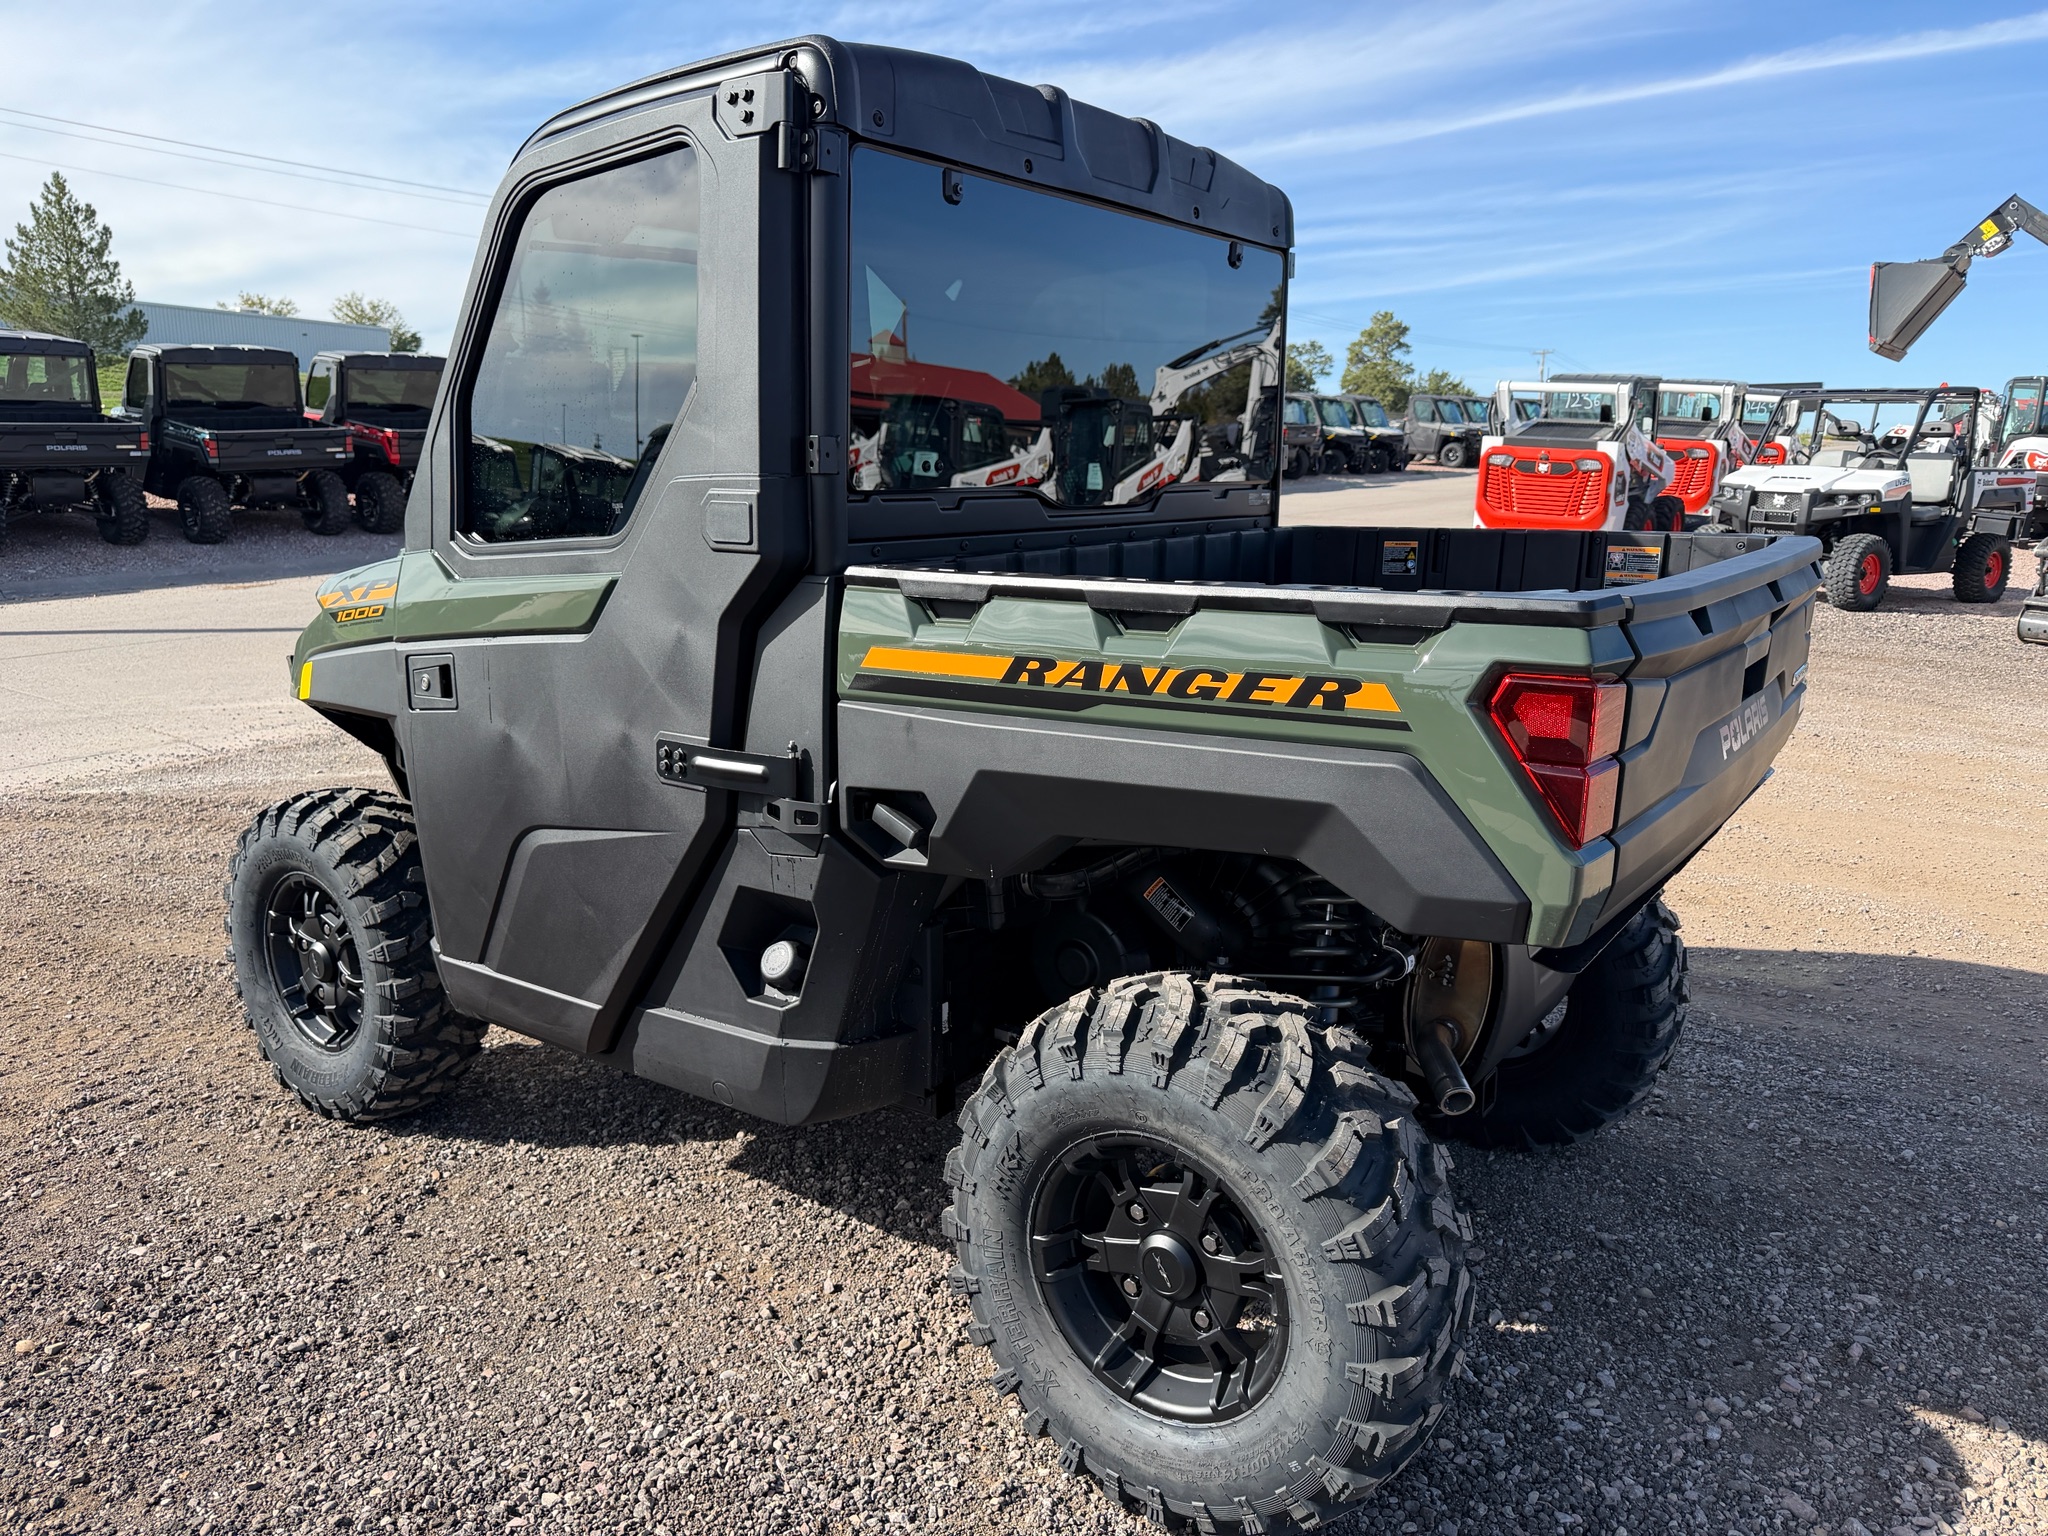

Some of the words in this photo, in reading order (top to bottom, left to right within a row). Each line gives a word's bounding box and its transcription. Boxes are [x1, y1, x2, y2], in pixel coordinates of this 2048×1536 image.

[328, 576, 397, 606] XP
[337, 605, 385, 622] 1000
[999, 655, 1363, 712] RANGER
[1719, 694, 1769, 761] POLARIS
[982, 1229, 1061, 1398] X-TERRAIN
